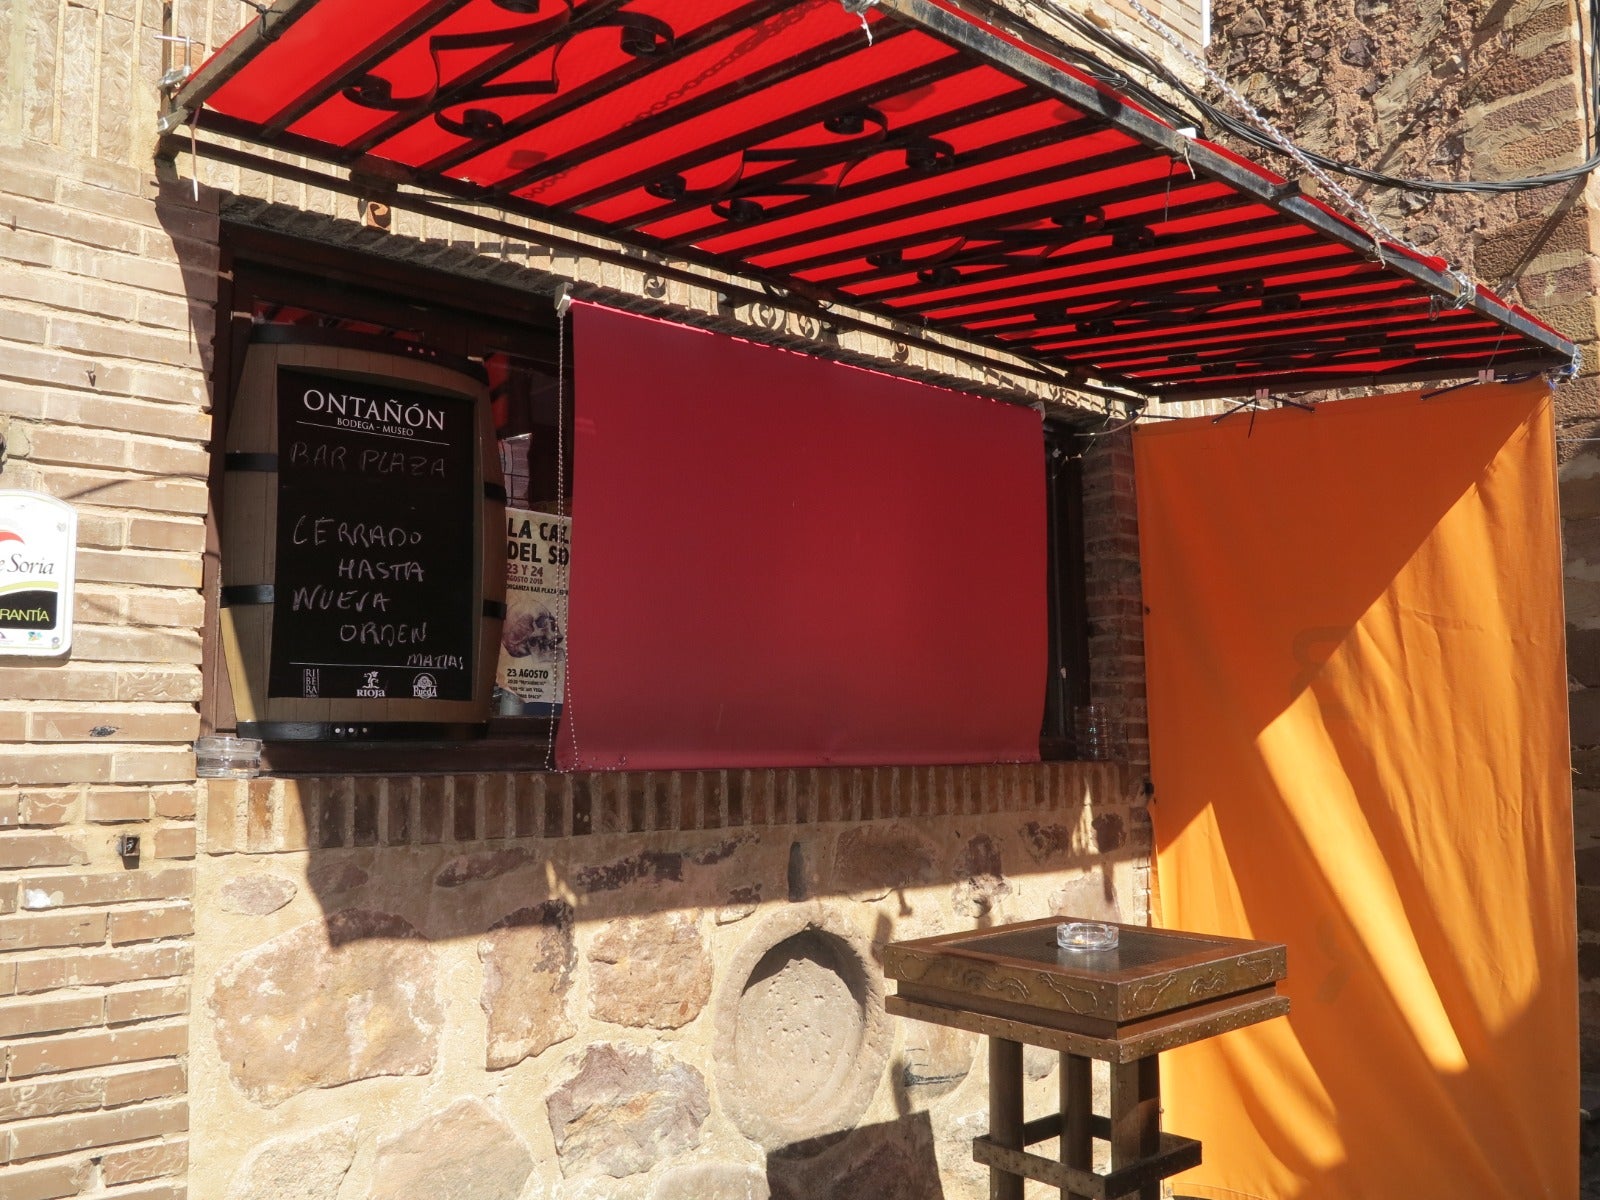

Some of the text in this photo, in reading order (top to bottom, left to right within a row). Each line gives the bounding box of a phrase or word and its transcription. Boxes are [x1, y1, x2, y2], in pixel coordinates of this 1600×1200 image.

[303, 389, 446, 431] ONTAÑÓN
[337, 417, 374, 430] BODEGA
[382, 425, 414, 436] MUSEO
[290, 441, 446, 478] BAR PLAZA
[293, 515, 422, 548] CERRADO
[507, 517, 532, 540] LA
[507, 540, 541, 563] DEL
[7, 553, 54, 575] Soria
[338, 558, 424, 582] HASTA
[507, 563, 543, 577] 23 Y 24
[507, 574, 528, 583] AGOSTO
[292, 584, 393, 612] NUEVA
[541, 587, 556, 595] PLAZA
[0, 607, 50, 622] RANTÍA
[340, 621, 427, 647] ORDEN
[406, 653, 464, 670] MATIAS
[507, 668, 549, 679] 23 AGOSTO
